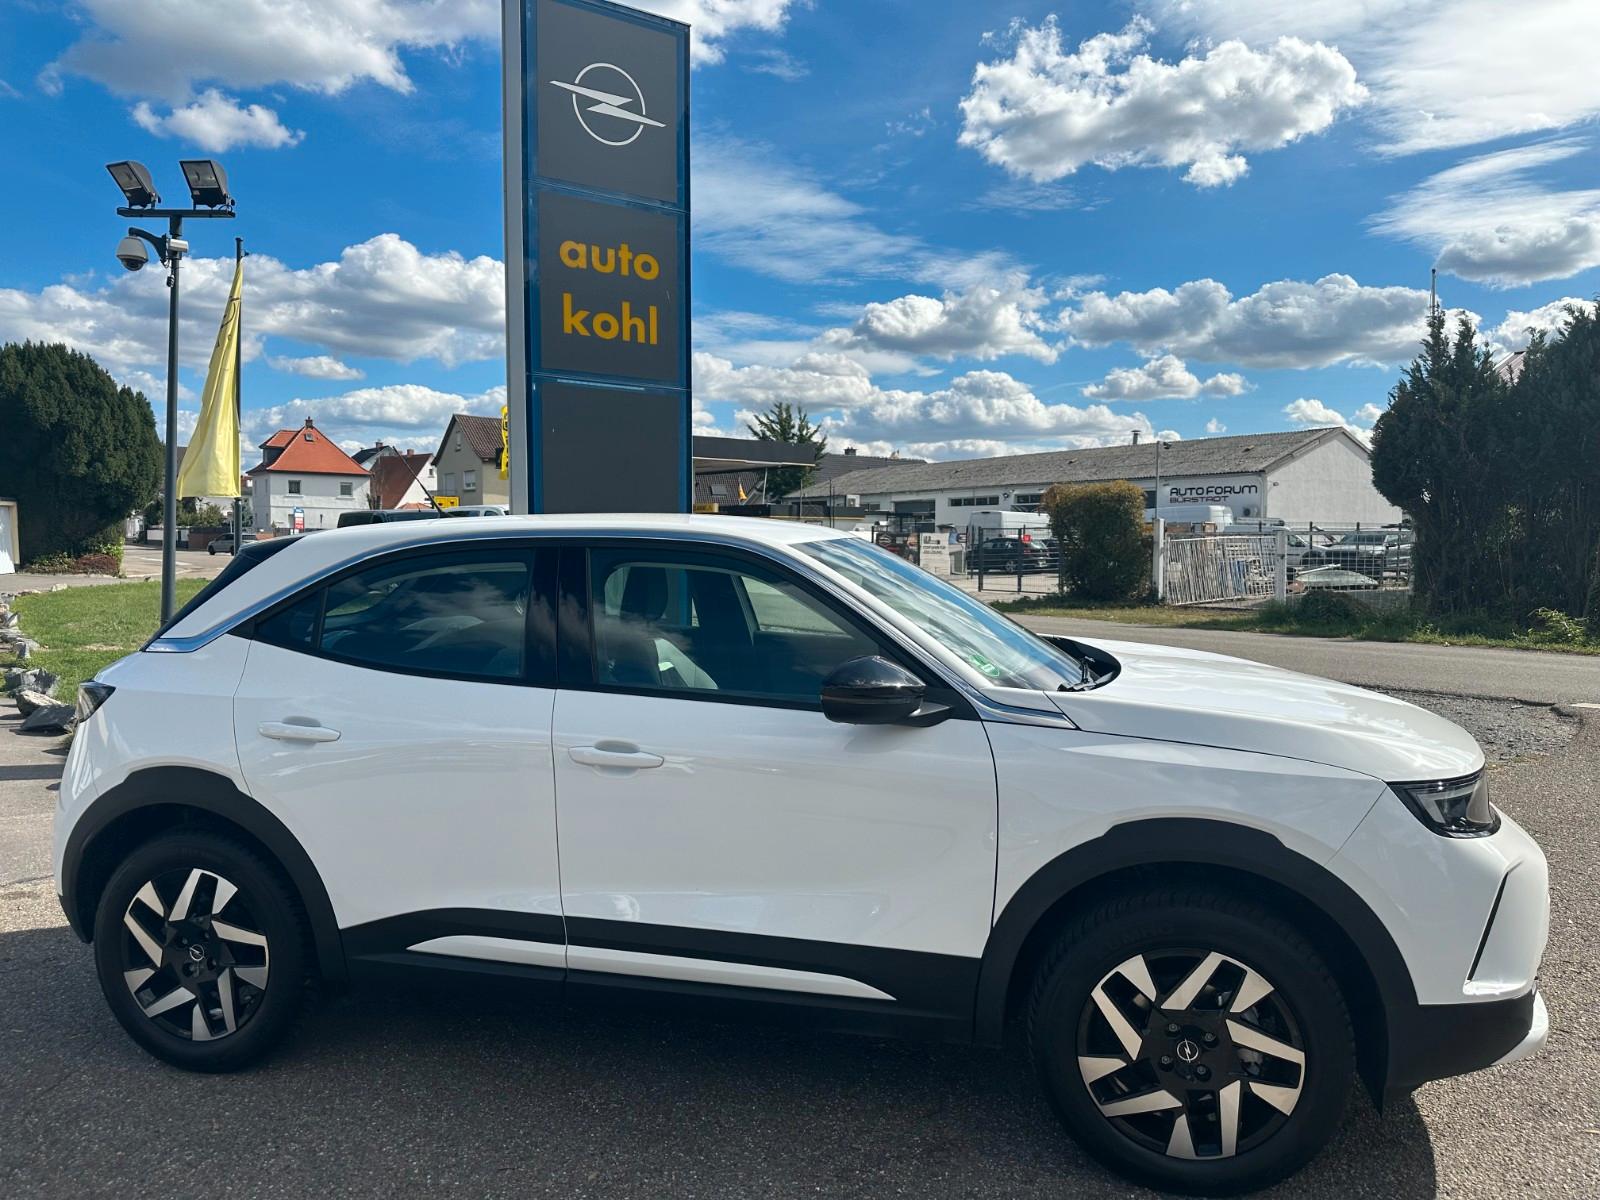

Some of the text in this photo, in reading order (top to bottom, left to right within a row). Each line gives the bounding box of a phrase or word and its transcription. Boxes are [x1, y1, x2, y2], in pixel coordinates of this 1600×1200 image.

[559, 240, 660, 281] auto
[563, 293, 658, 345] kohl
[1170, 485, 1258, 497] AUTO FORUM
